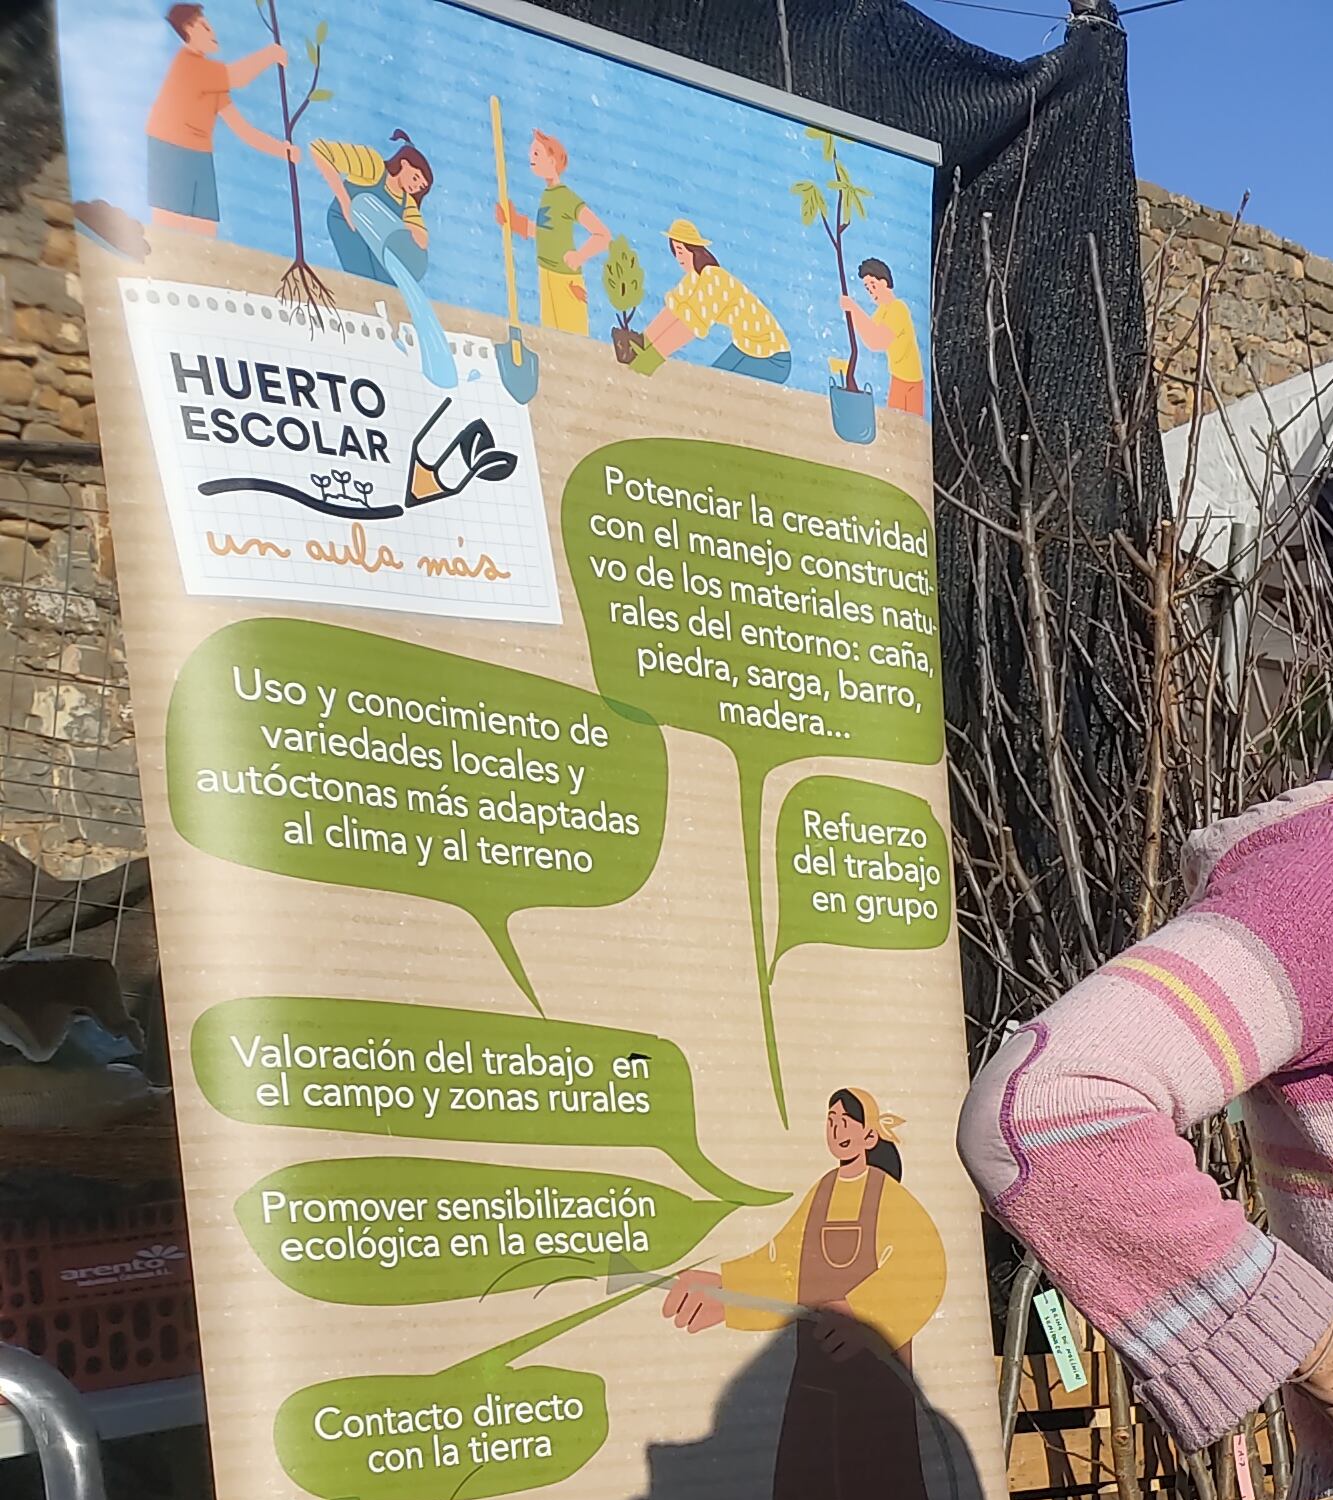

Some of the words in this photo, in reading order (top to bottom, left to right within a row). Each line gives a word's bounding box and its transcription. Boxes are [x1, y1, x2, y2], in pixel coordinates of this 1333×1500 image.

[170, 353, 387, 419] HUERTO
[180, 405, 391, 464] ESCOLAR
[604, 466, 742, 523] Potenciar
[751, 491, 774, 527] la
[783, 504, 928, 557] creatividad
[206, 529, 289, 560] un
[306, 523, 403, 573] aula
[418, 536, 511, 581] más
[589, 513, 643, 543] con
[652, 520, 678, 548] el
[688, 527, 791, 574] manejo
[800, 546, 934, 597] constructi-
[591, 555, 628, 580] vo
[637, 554, 673, 588] de
[683, 561, 722, 596] los
[730, 570, 873, 627] materiales
[882, 602, 937, 635] natu-
[609, 598, 680, 632] rales
[688, 607, 732, 641] del
[740, 619, 860, 665] entorno:
[869, 635, 934, 677] caña,
[232, 666, 306, 706] Uso
[317, 685, 338, 714] y
[346, 685, 560, 744] conocimiento
[570, 714, 609, 748] de
[637, 643, 739, 684] piedra,
[748, 665, 831, 706] sarga,
[838, 672, 922, 715] barro,
[718, 696, 851, 741] madera...
[262, 716, 442, 773] variedades
[452, 740, 560, 785] locales
[570, 763, 584, 795] y
[197, 762, 398, 809] autóctonas
[407, 781, 469, 816] más
[477, 791, 639, 838] adaptadas
[283, 814, 316, 846] al
[324, 819, 408, 856] clima
[417, 838, 433, 866] y
[443, 828, 469, 861] al
[477, 838, 592, 873] terreno
[803, 809, 927, 850] Refuerzo
[793, 847, 834, 878] del
[844, 851, 941, 889] trabajo
[812, 892, 848, 912] en
[856, 895, 938, 924] grupo
[230, 1034, 415, 1072] Valoración
[425, 1040, 474, 1075] del
[483, 1044, 595, 1081] trabajo
[612, 1058, 649, 1080] en
[256, 1077, 292, 1108] el
[302, 1084, 413, 1116] campo
[423, 1089, 439, 1117] y
[448, 1088, 541, 1112] zonas
[548, 1081, 650, 1114] rurales
[261, 1191, 427, 1223] Promover
[438, 1188, 656, 1223] sensibilización
[280, 1223, 440, 1266] ecológica
[449, 1233, 489, 1257] en
[498, 1223, 526, 1255] la
[534, 1223, 649, 1255] escuela
[313, 1401, 464, 1441] Contacto
[473, 1394, 584, 1428] directo
[367, 1442, 423, 1473] con
[434, 1436, 459, 1469] la
[468, 1430, 552, 1462] tierra
